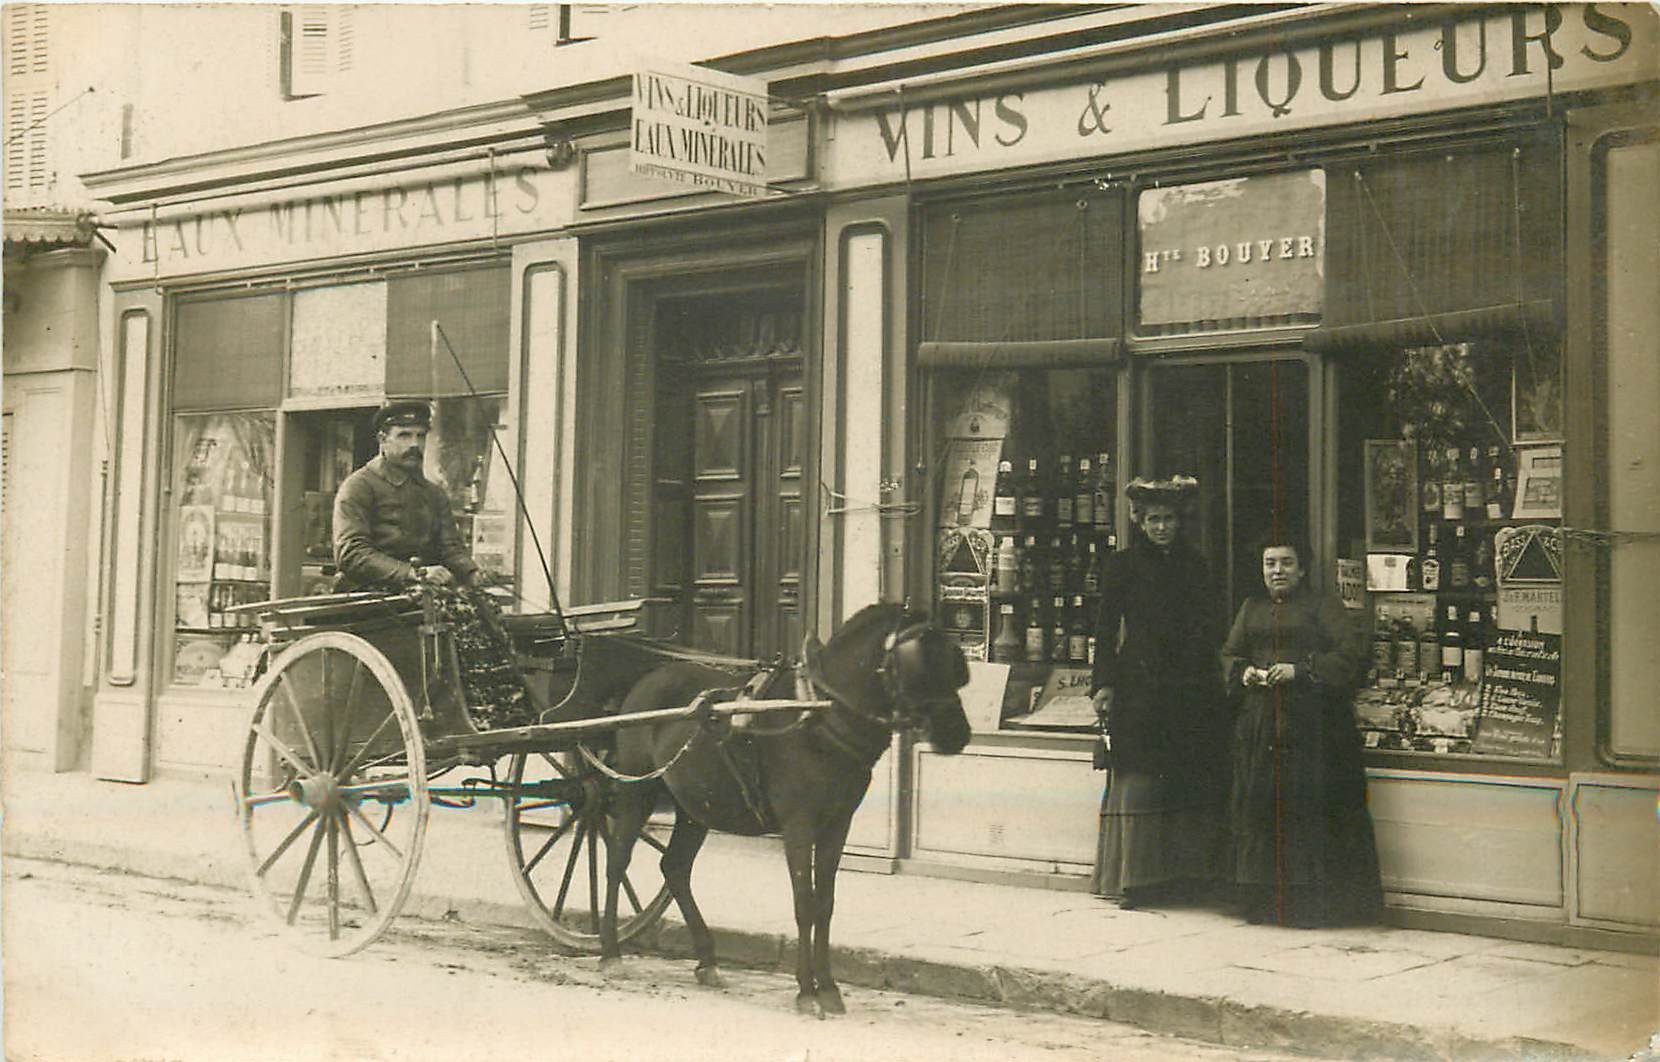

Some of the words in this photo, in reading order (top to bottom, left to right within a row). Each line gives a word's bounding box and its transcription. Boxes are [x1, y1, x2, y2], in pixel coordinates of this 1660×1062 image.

[636, 73, 674, 110] VINS
[686, 84, 766, 132] LIQUEURS
[875, 93, 1028, 163] VINS
[1078, 81, 1112, 137] &
[1162, 2, 1633, 126] LIQUEURS
[635, 119, 677, 159] EAUX
[142, 208, 245, 263] EAUX
[1195, 236, 1313, 267] BOUYER
